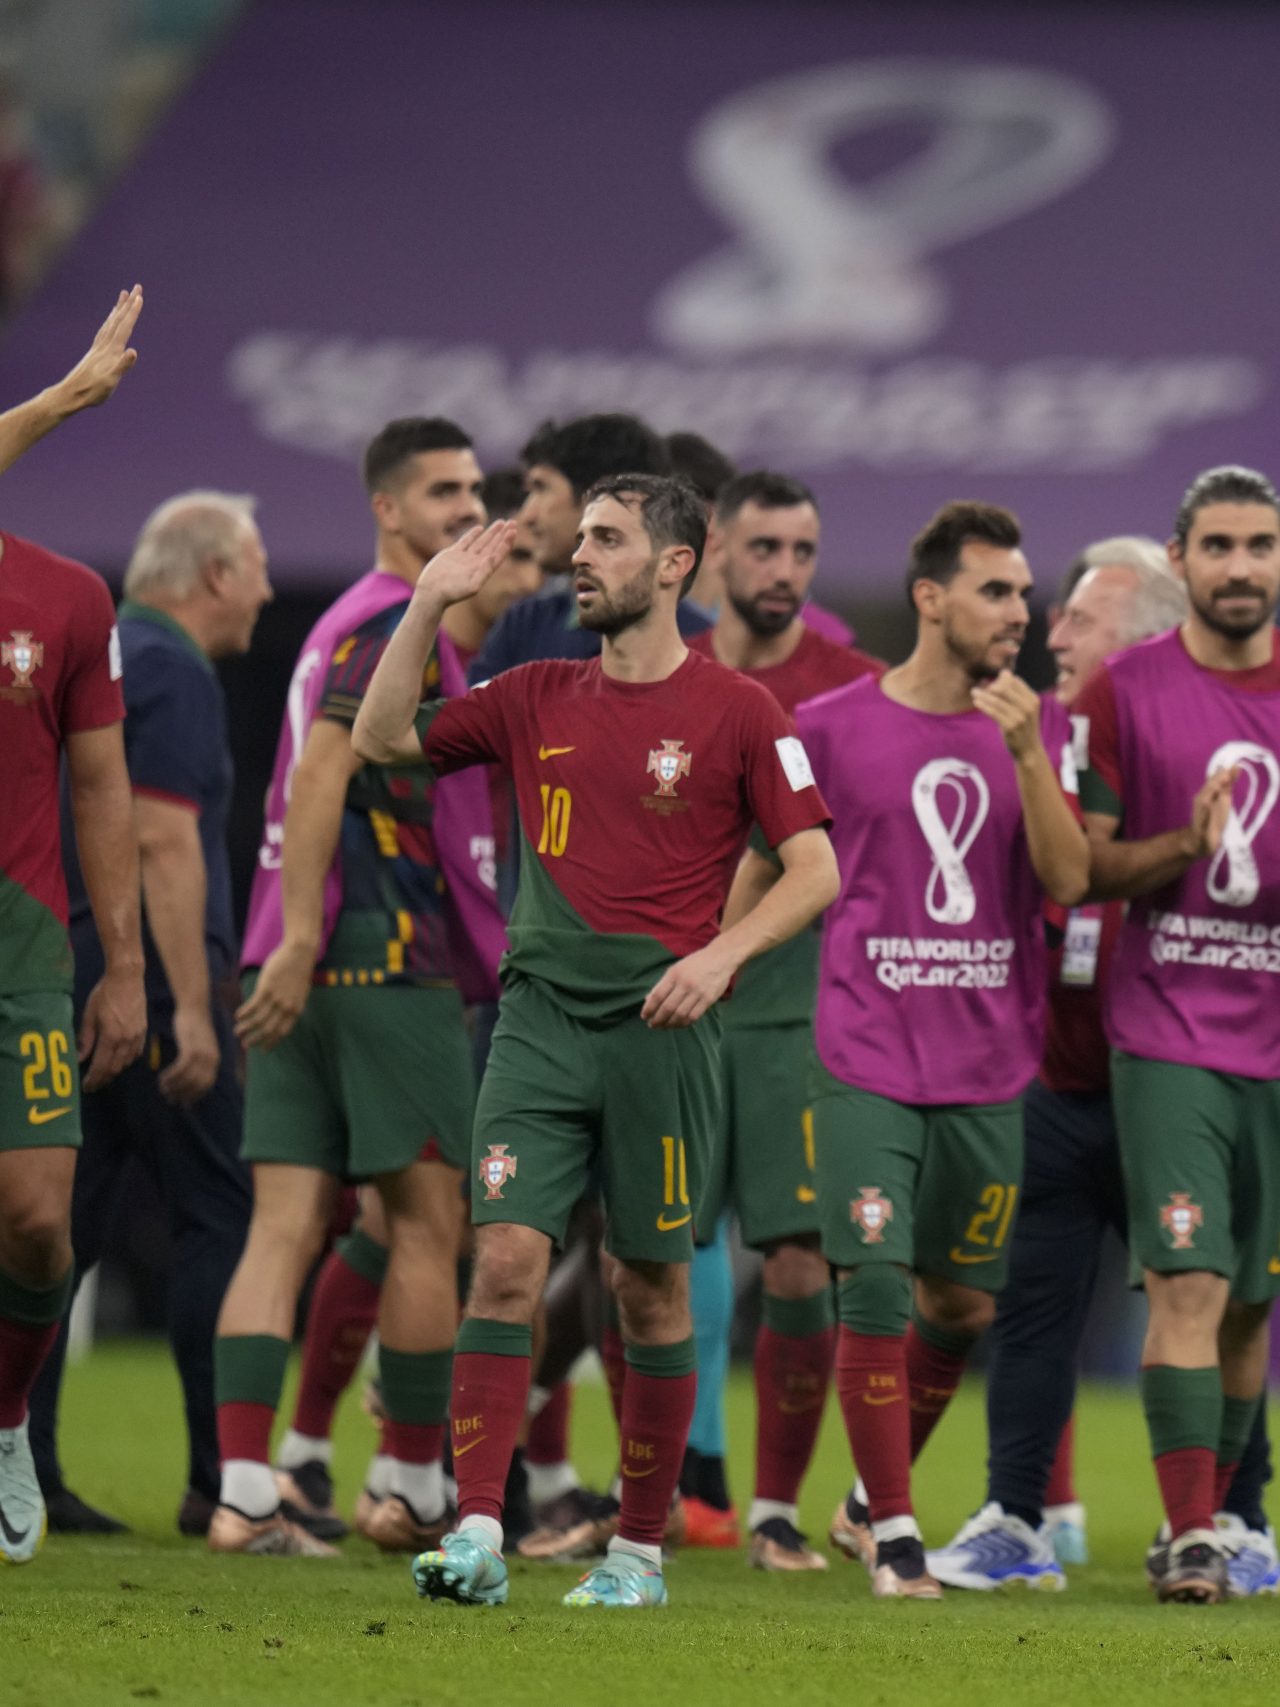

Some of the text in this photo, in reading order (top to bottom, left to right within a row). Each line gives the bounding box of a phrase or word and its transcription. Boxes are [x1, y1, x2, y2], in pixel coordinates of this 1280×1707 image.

[537, 784, 572, 857] 10
[866, 936, 914, 961] FIFA
[914, 937, 988, 962] WORLD
[1188, 915, 1269, 945] WORLD
[20, 1030, 72, 1100] 26
[964, 1183, 1019, 1249] 21
